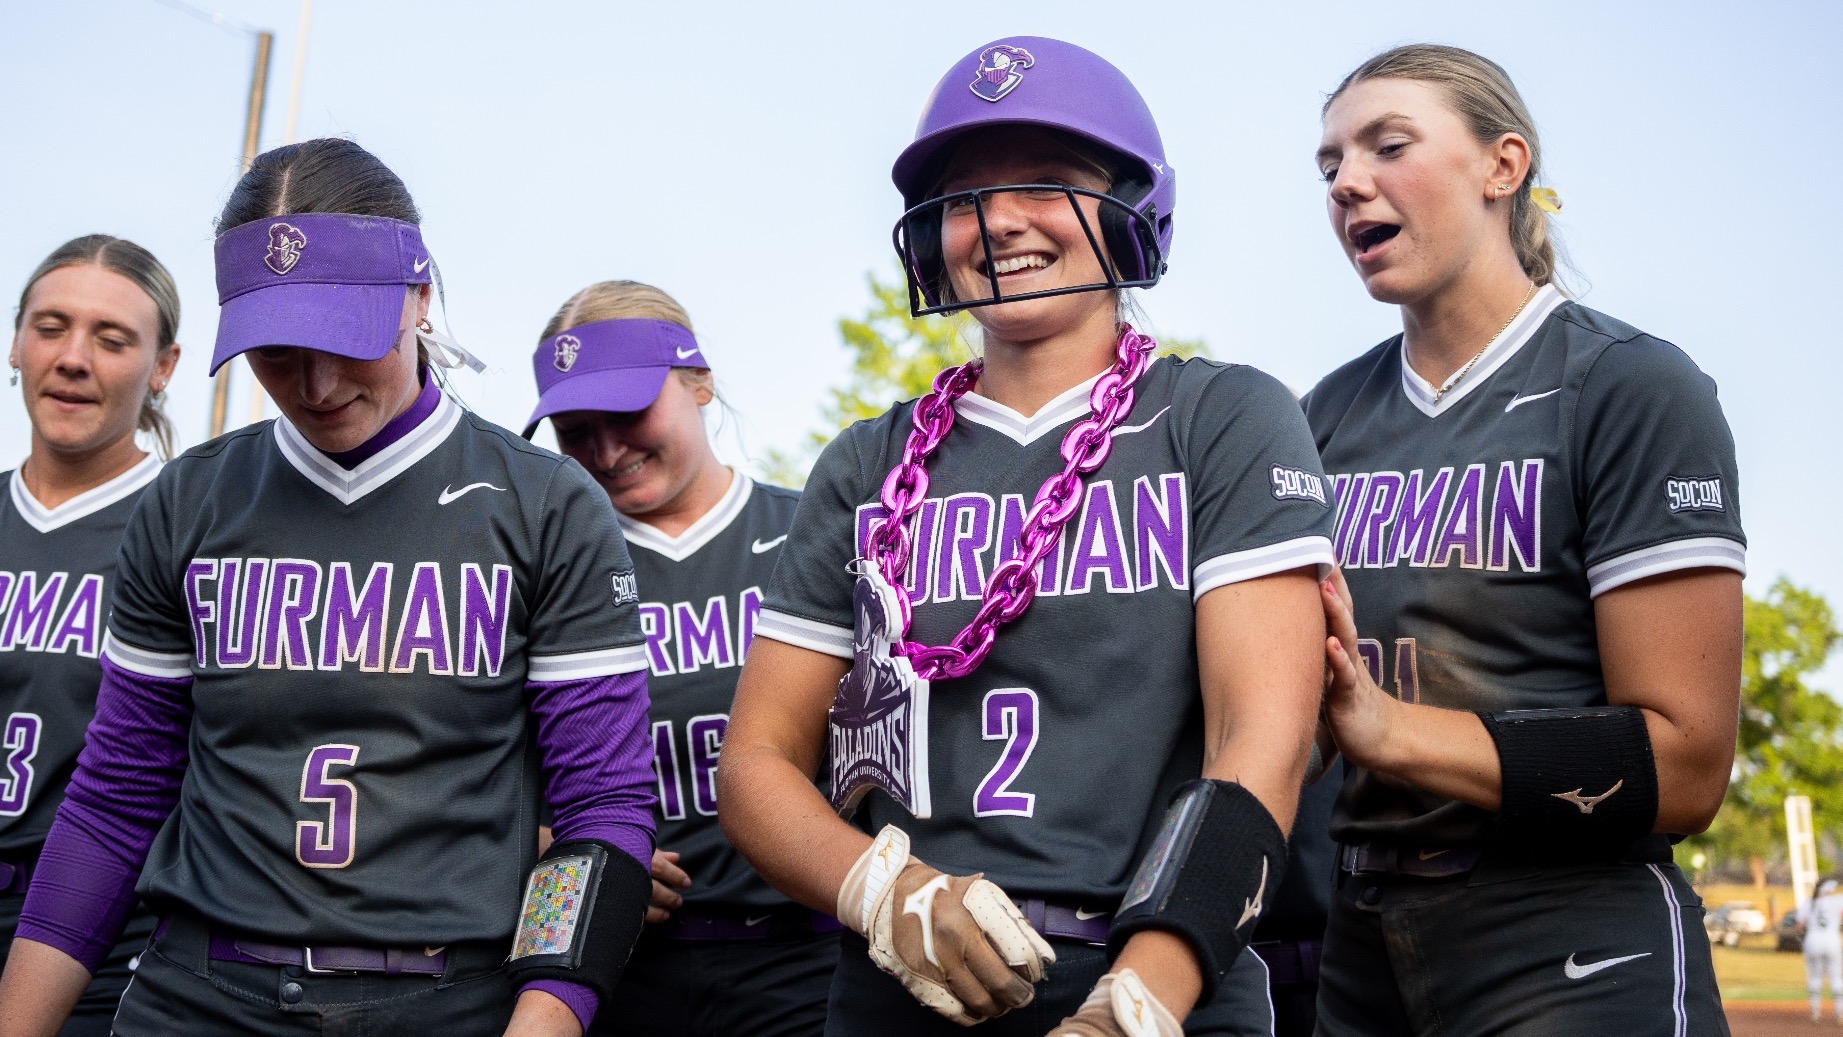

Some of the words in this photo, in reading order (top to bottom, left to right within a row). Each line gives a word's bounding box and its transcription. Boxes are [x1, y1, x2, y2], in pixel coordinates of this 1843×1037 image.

[1326, 459, 1544, 573] URMAN
[184, 558, 512, 677] FURMAN
[295, 743, 360, 868] 5
[832, 701, 907, 802] PALADINS
[860, 765, 890, 788] UNIVERSITY
[973, 688, 1040, 818] 2
